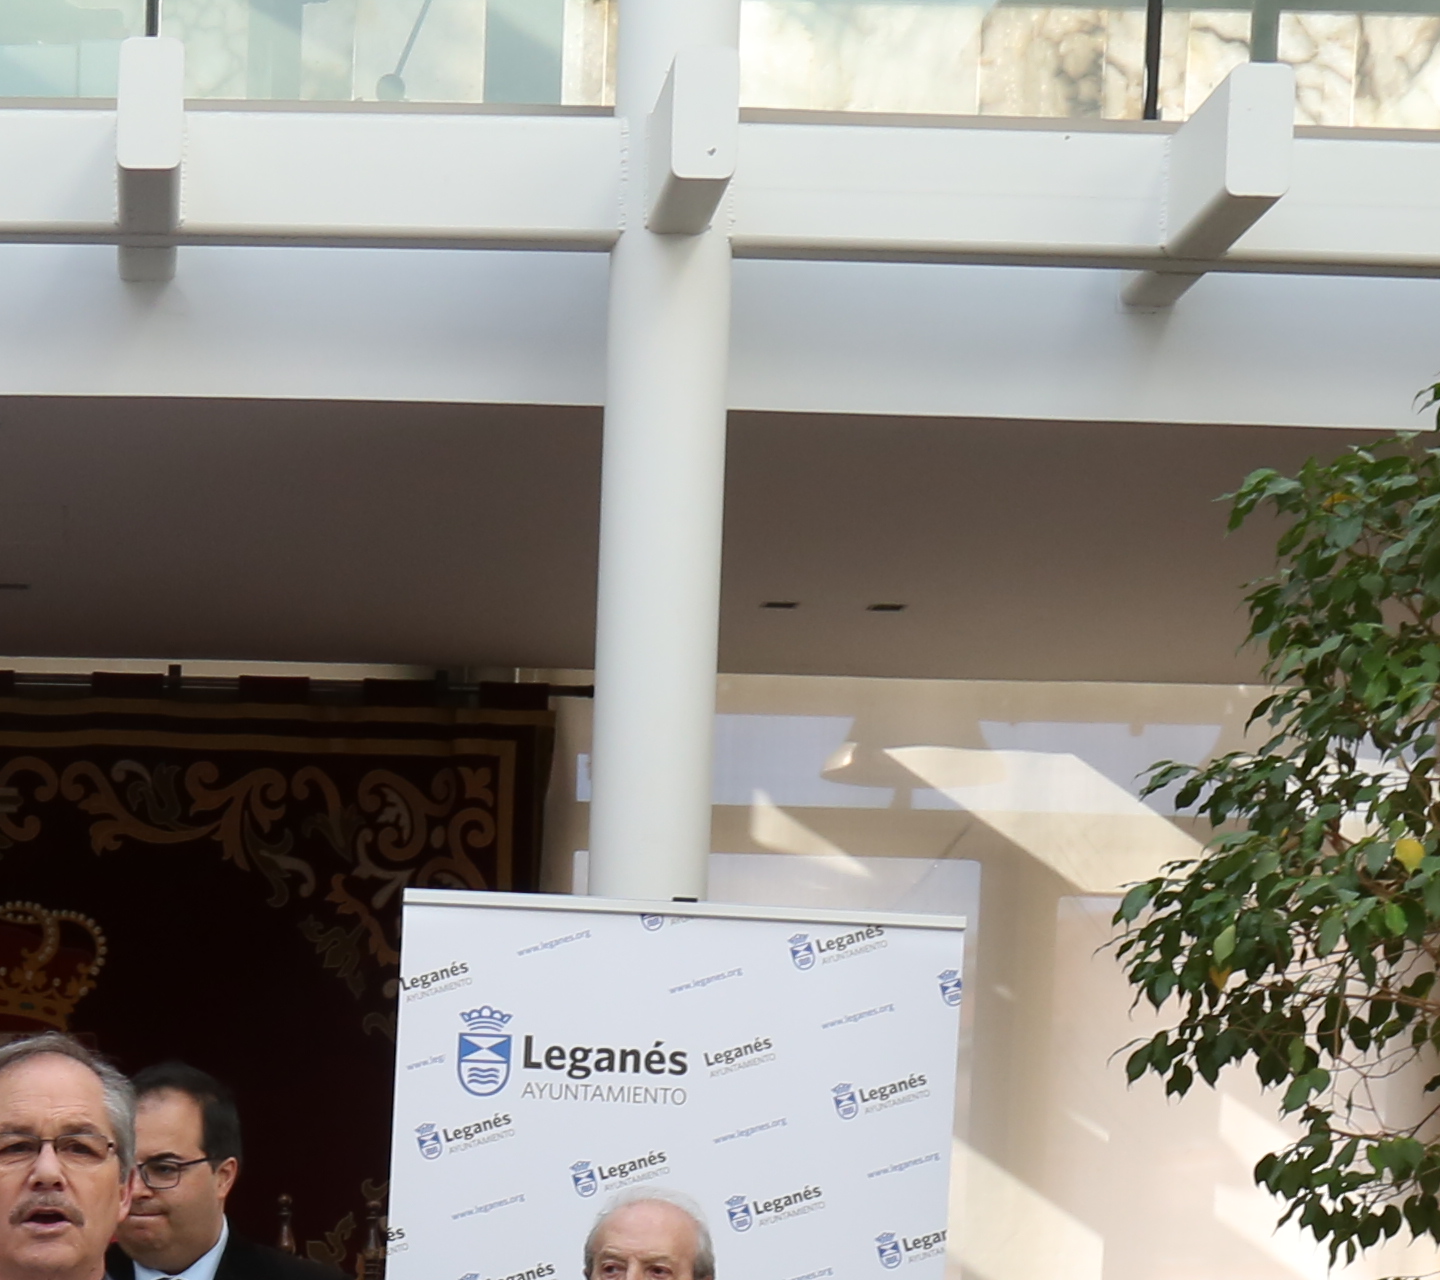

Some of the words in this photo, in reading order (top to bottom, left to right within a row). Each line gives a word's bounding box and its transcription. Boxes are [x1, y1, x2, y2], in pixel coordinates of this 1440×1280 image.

[816, 925, 884, 953] Leganés
[400, 961, 469, 991] Leganés
[523, 1035, 689, 1079] Leganés
[703, 1036, 773, 1067] Leganés
[521, 1082, 688, 1105] AYUNTAMIENTO
[859, 1073, 927, 1103] Leganés
[442, 1112, 512, 1142] Leganés
[597, 1150, 667, 1180] Leganés
[753, 1184, 822, 1215] Leganés
